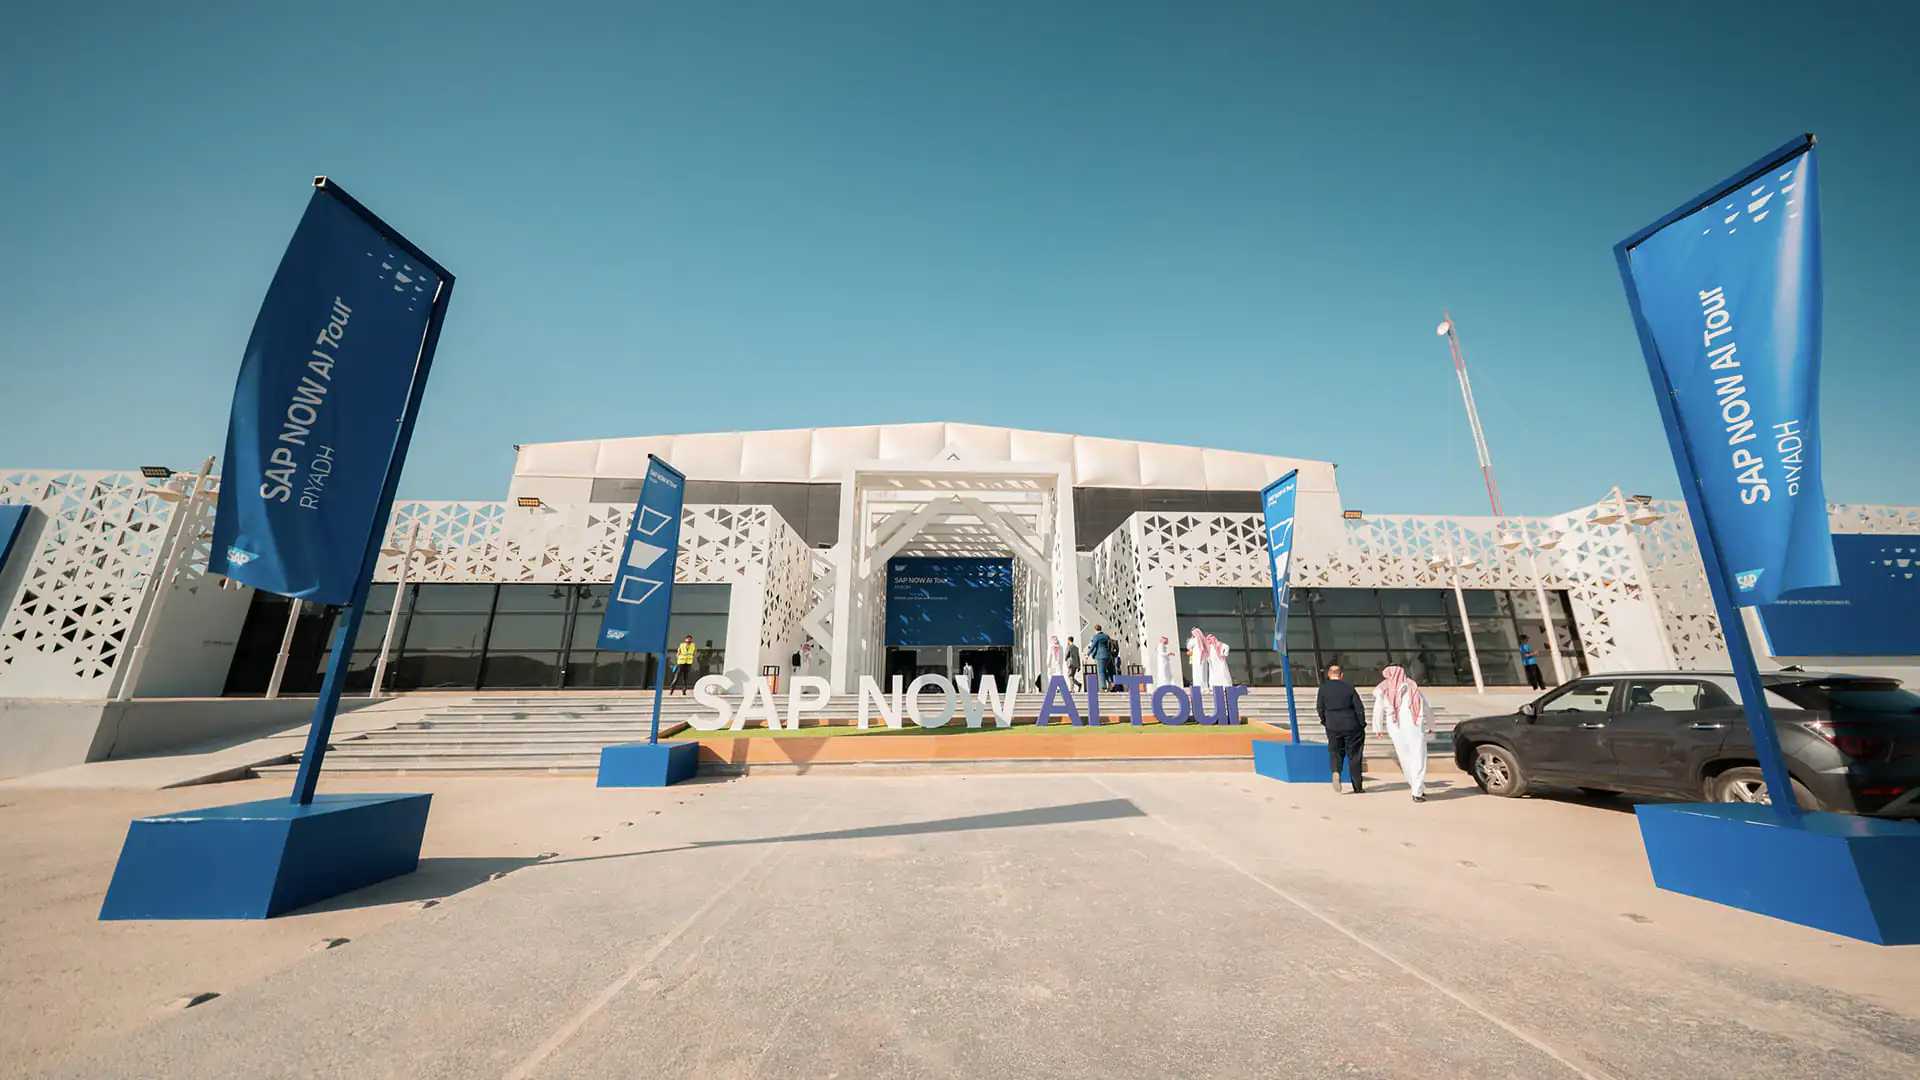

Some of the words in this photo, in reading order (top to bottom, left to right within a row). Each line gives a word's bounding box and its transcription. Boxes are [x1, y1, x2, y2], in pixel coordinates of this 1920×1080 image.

[316, 296, 352, 349] Tour
[1698, 286, 1733, 347] Tour
[308, 350, 335, 381] AI
[1707, 342, 1741, 370] AI
[278, 376, 328, 446] NOW
[1714, 374, 1757, 446] NOW
[260, 447, 297, 503] SAP
[300, 445, 335, 510] RIYADH
[1732, 448, 1771, 505] SAP
[226, 549, 250, 565] SAP
[894, 576, 909, 584] SAP
[909, 576, 926, 584] NOW
[1737, 574, 1757, 588] SAP
[606, 630, 625, 640] SAP
[687, 674, 831, 731] SAP
[857, 673, 1022, 730] NOW
[1036, 674, 1100, 727] AI
[1113, 674, 1249, 727] Tour
